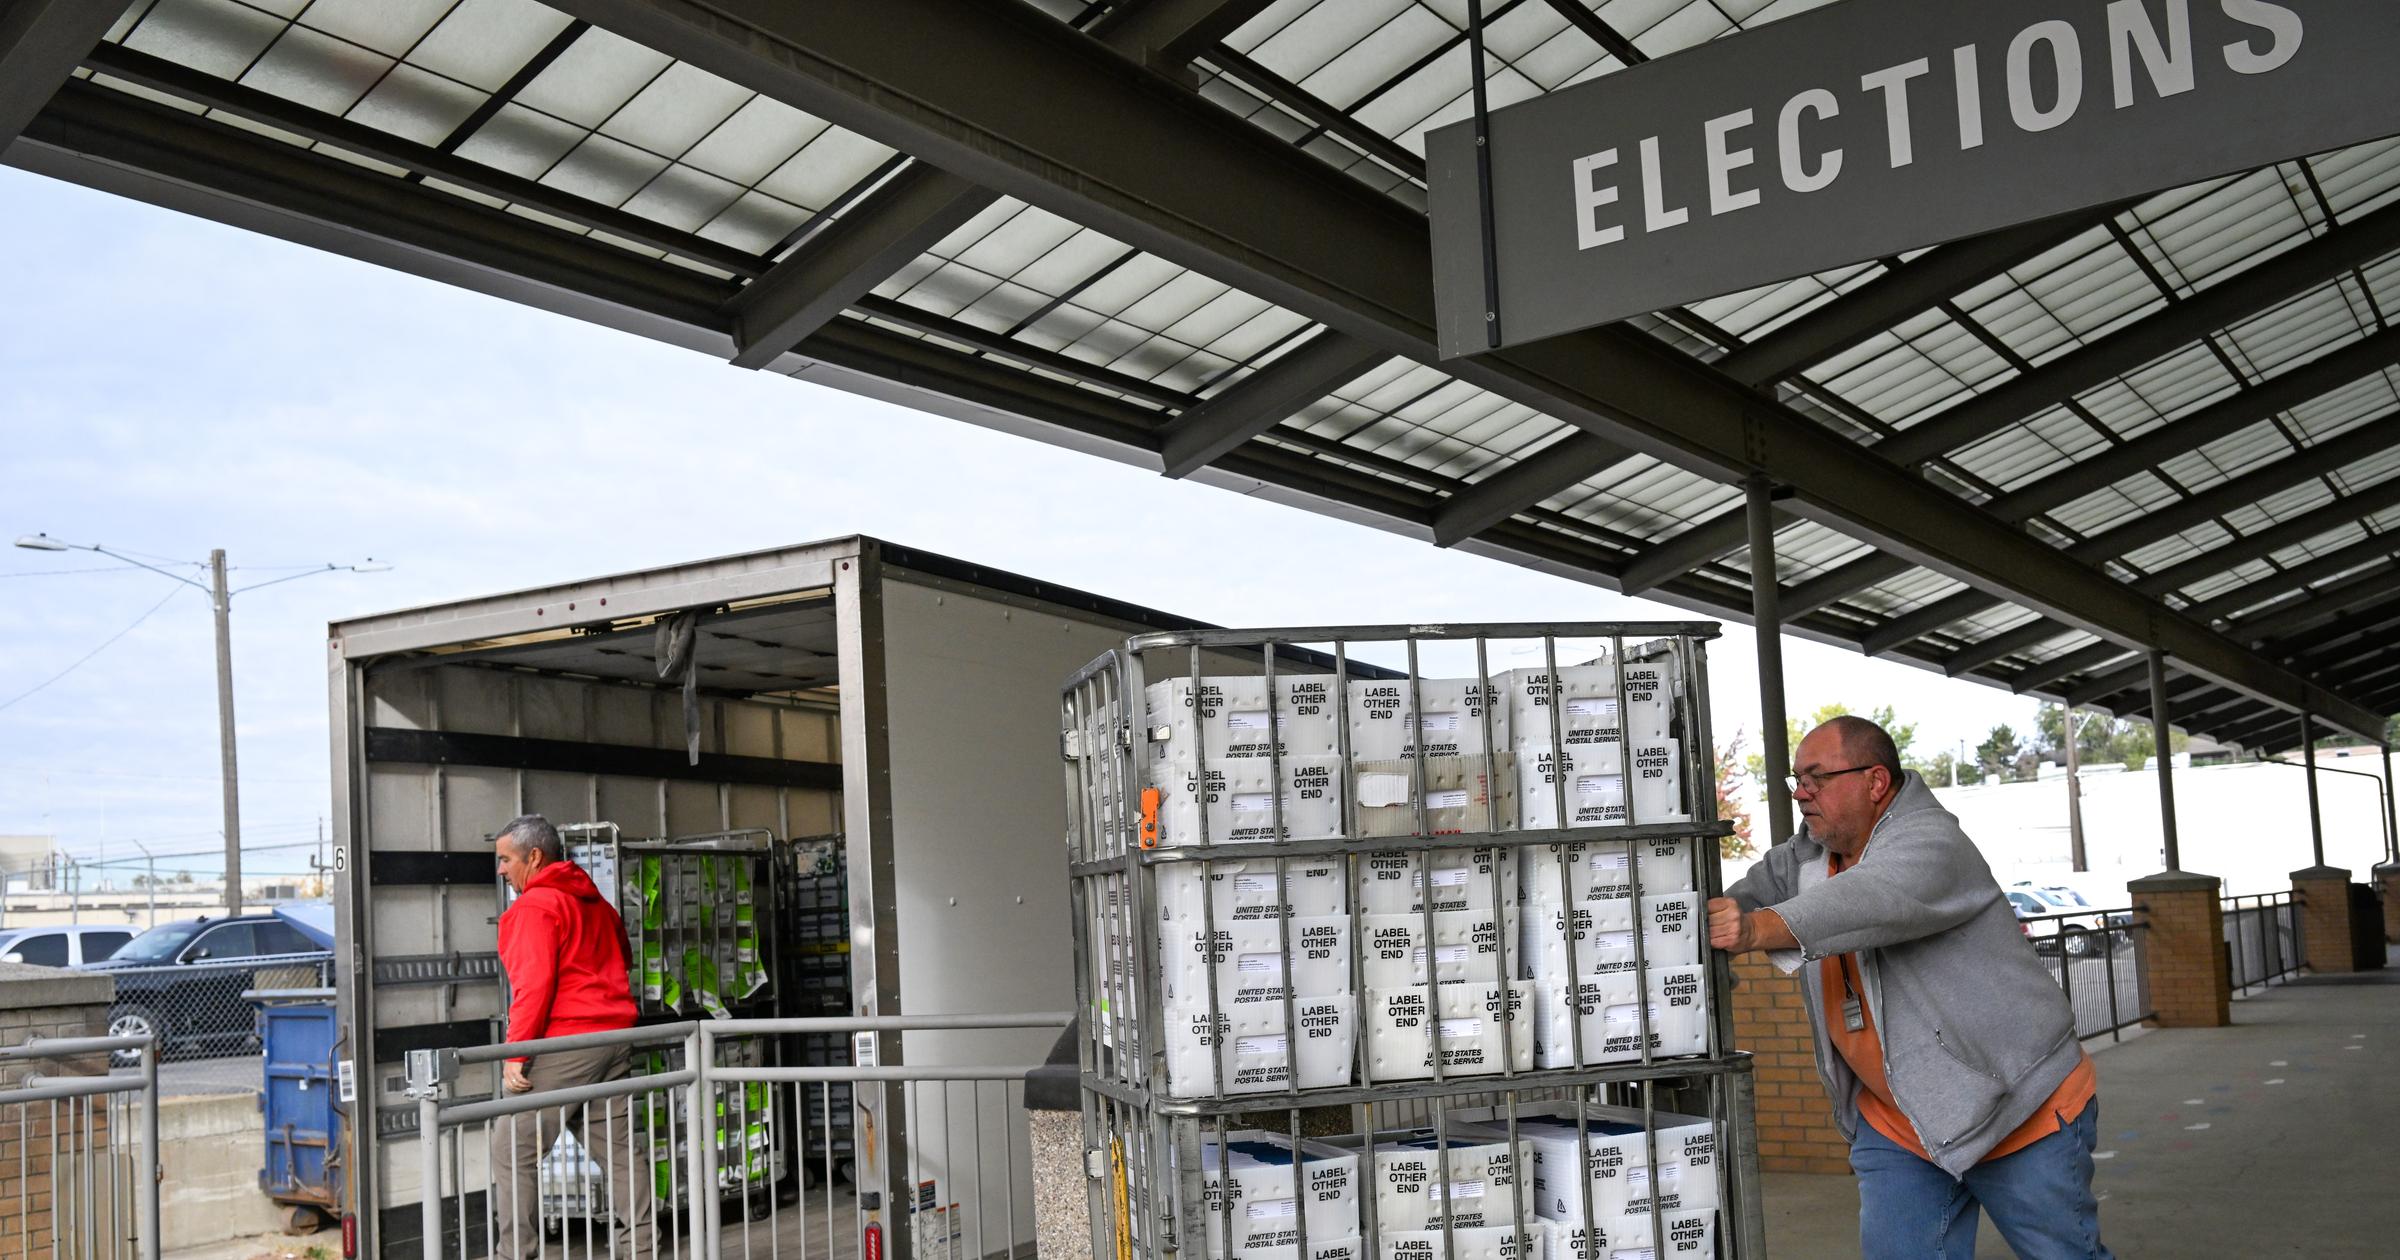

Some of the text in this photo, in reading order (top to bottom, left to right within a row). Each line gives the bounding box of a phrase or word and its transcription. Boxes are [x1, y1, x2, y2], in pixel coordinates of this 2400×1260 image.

[1573, 0, 2304, 251] ELECTIONS
[1528, 675, 1562, 684] LABL
[1627, 671, 1657, 680] LABEL
[1186, 686, 1223, 695] LBEL
[1292, 683, 1325, 693] LABEL
[1466, 686, 1497, 695] LAEL
[1527, 686, 1562, 695] OTHR
[1626, 682, 1658, 691] OTHER
[1365, 688, 1400, 697] LABEL
[1632, 693, 1652, 701] END
[1185, 698, 1223, 707] OHER
[1291, 694, 1326, 704] OTHER
[1364, 699, 1400, 708] OTHER
[1535, 697, 1550, 705] EN
[1298, 706, 1319, 715] END
[1370, 710, 1392, 719] END
[1471, 708, 1484, 716] EN
[1637, 748, 1667, 756] LABEL
[1539, 753, 1573, 762] LAEL
[1637, 758, 1668, 767] OTHER
[1295, 767, 1328, 777] LABEL
[1538, 763, 1573, 772] OTER
[1643, 769, 1662, 778] END
[1294, 778, 1328, 788] OTHER
[1301, 790, 1322, 798] END
[1649, 837, 1681, 846] OTHER
[1371, 849, 1408, 857] LABEL
[1656, 847, 1675, 857] END
[336, 847, 344, 870] 6
[1473, 854, 1506, 863] OTHR
[1371, 859, 1408, 869] OTHER
[1306, 869, 1328, 877] END
[1479, 865, 1493, 873] EN
[1378, 871, 1401, 880] END
[1590, 885, 1616, 893] UNITED
[1440, 901, 1466, 909] STATES
[1656, 902, 1687, 912] LABEL
[1557, 910, 1592, 919] LBEL
[1656, 913, 1687, 923] OTHER
[1556, 921, 1592, 930] OHER
[1662, 924, 1681, 933] END
[1302, 927, 1336, 936] LABEL
[1375, 928, 1410, 937] LABEL
[1472, 933, 1496, 943] OTHE
[1301, 938, 1336, 948] OTHER
[1374, 939, 1410, 948] OTHER
[1202, 954, 1225, 963] ED
[1308, 950, 1330, 959] END
[1381, 950, 1403, 959] END
[1597, 962, 1622, 970] UNITED
[1664, 975, 1696, 985] LABEL
[1238, 988, 1265, 996] UNITED
[1566, 984, 1600, 994] LBEL
[1664, 986, 1697, 995] OTHER
[1487, 990, 1520, 1000] LAEL
[1389, 995, 1424, 1005] LABEL
[1565, 995, 1601, 1005] OHER
[1671, 996, 1691, 1006] END
[1302, 1005, 1338, 1016] LABEL
[1486, 1001, 1521, 1011] OTER
[1389, 1006, 1425, 1016] OTHER
[1576, 1007, 1594, 1015] ND
[1193, 1013, 1230, 1023] LAEL
[1494, 1012, 1514, 1021] ED
[1301, 1016, 1339, 1027] OTHER
[1396, 1018, 1418, 1027] END
[1309, 1028, 1332, 1038] END
[1606, 1036, 1632, 1044] UNITED
[1603, 1044, 1631, 1053] POSTAL
[1454, 1057, 1484, 1065] SERVICE
[1267, 1067, 1289, 1075] STATE
[1235, 1076, 1263, 1085] POSTAL
[1589, 1147, 1622, 1157] LABEL
[1589, 1157, 1623, 1168] OTHER
[1691, 1156, 1710, 1166] END
[1391, 1162, 1426, 1171] LABEL
[1488, 1166, 1512, 1175] OTHE
[1313, 1167, 1346, 1179] LABEL
[1390, 1173, 1426, 1182] OTHER
[1595, 1169, 1616, 1179] END
[1204, 1179, 1241, 1189] LAEL
[1312, 1178, 1347, 1191] OTHER
[1495, 1176, 1513, 1186] END
[1397, 1184, 1419, 1193] END
[1319, 1190, 1340, 1201] END
[1625, 1206, 1651, 1215] POSTAL
[1428, 1215, 1454, 1223] UNITD
[1454, 1220, 1485, 1228] SERVICE
[1672, 1219, 1703, 1230] LABEL
[1248, 1232, 1276, 1241] UNITED
[1572, 1228, 1606, 1238] LAEL
[1671, 1229, 1704, 1240] OTHER
[1501, 1234, 1532, 1244] LAEL
[1396, 1241, 1432, 1250] LABEL
[1571, 1239, 1606, 1249] OTER
[1677, 1241, 1697, 1251] END
[1316, 1248, 1349, 1260] LABEL
[1395, 1252, 1432, 1260] OTHER
